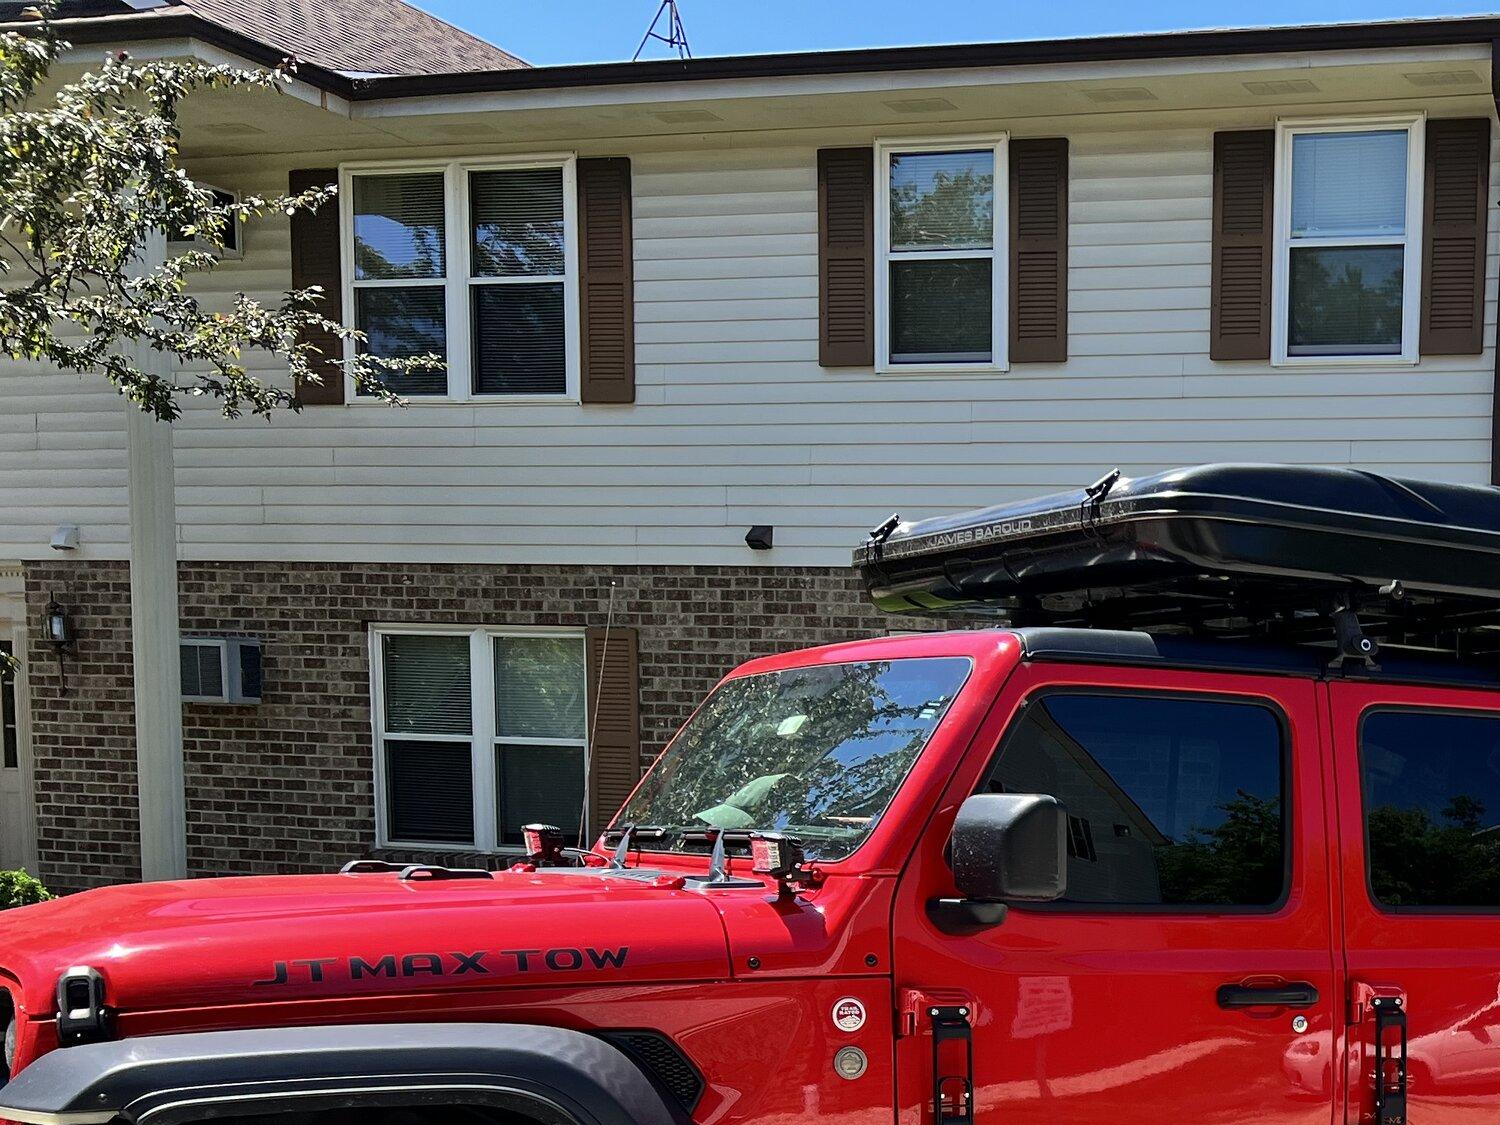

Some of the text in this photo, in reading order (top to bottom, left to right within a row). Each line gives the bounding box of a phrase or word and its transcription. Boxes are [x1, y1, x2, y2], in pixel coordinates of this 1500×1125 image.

[929, 520, 1032, 547] JAMES BAROUD
[251, 946, 631, 985] JT MAX TOW
